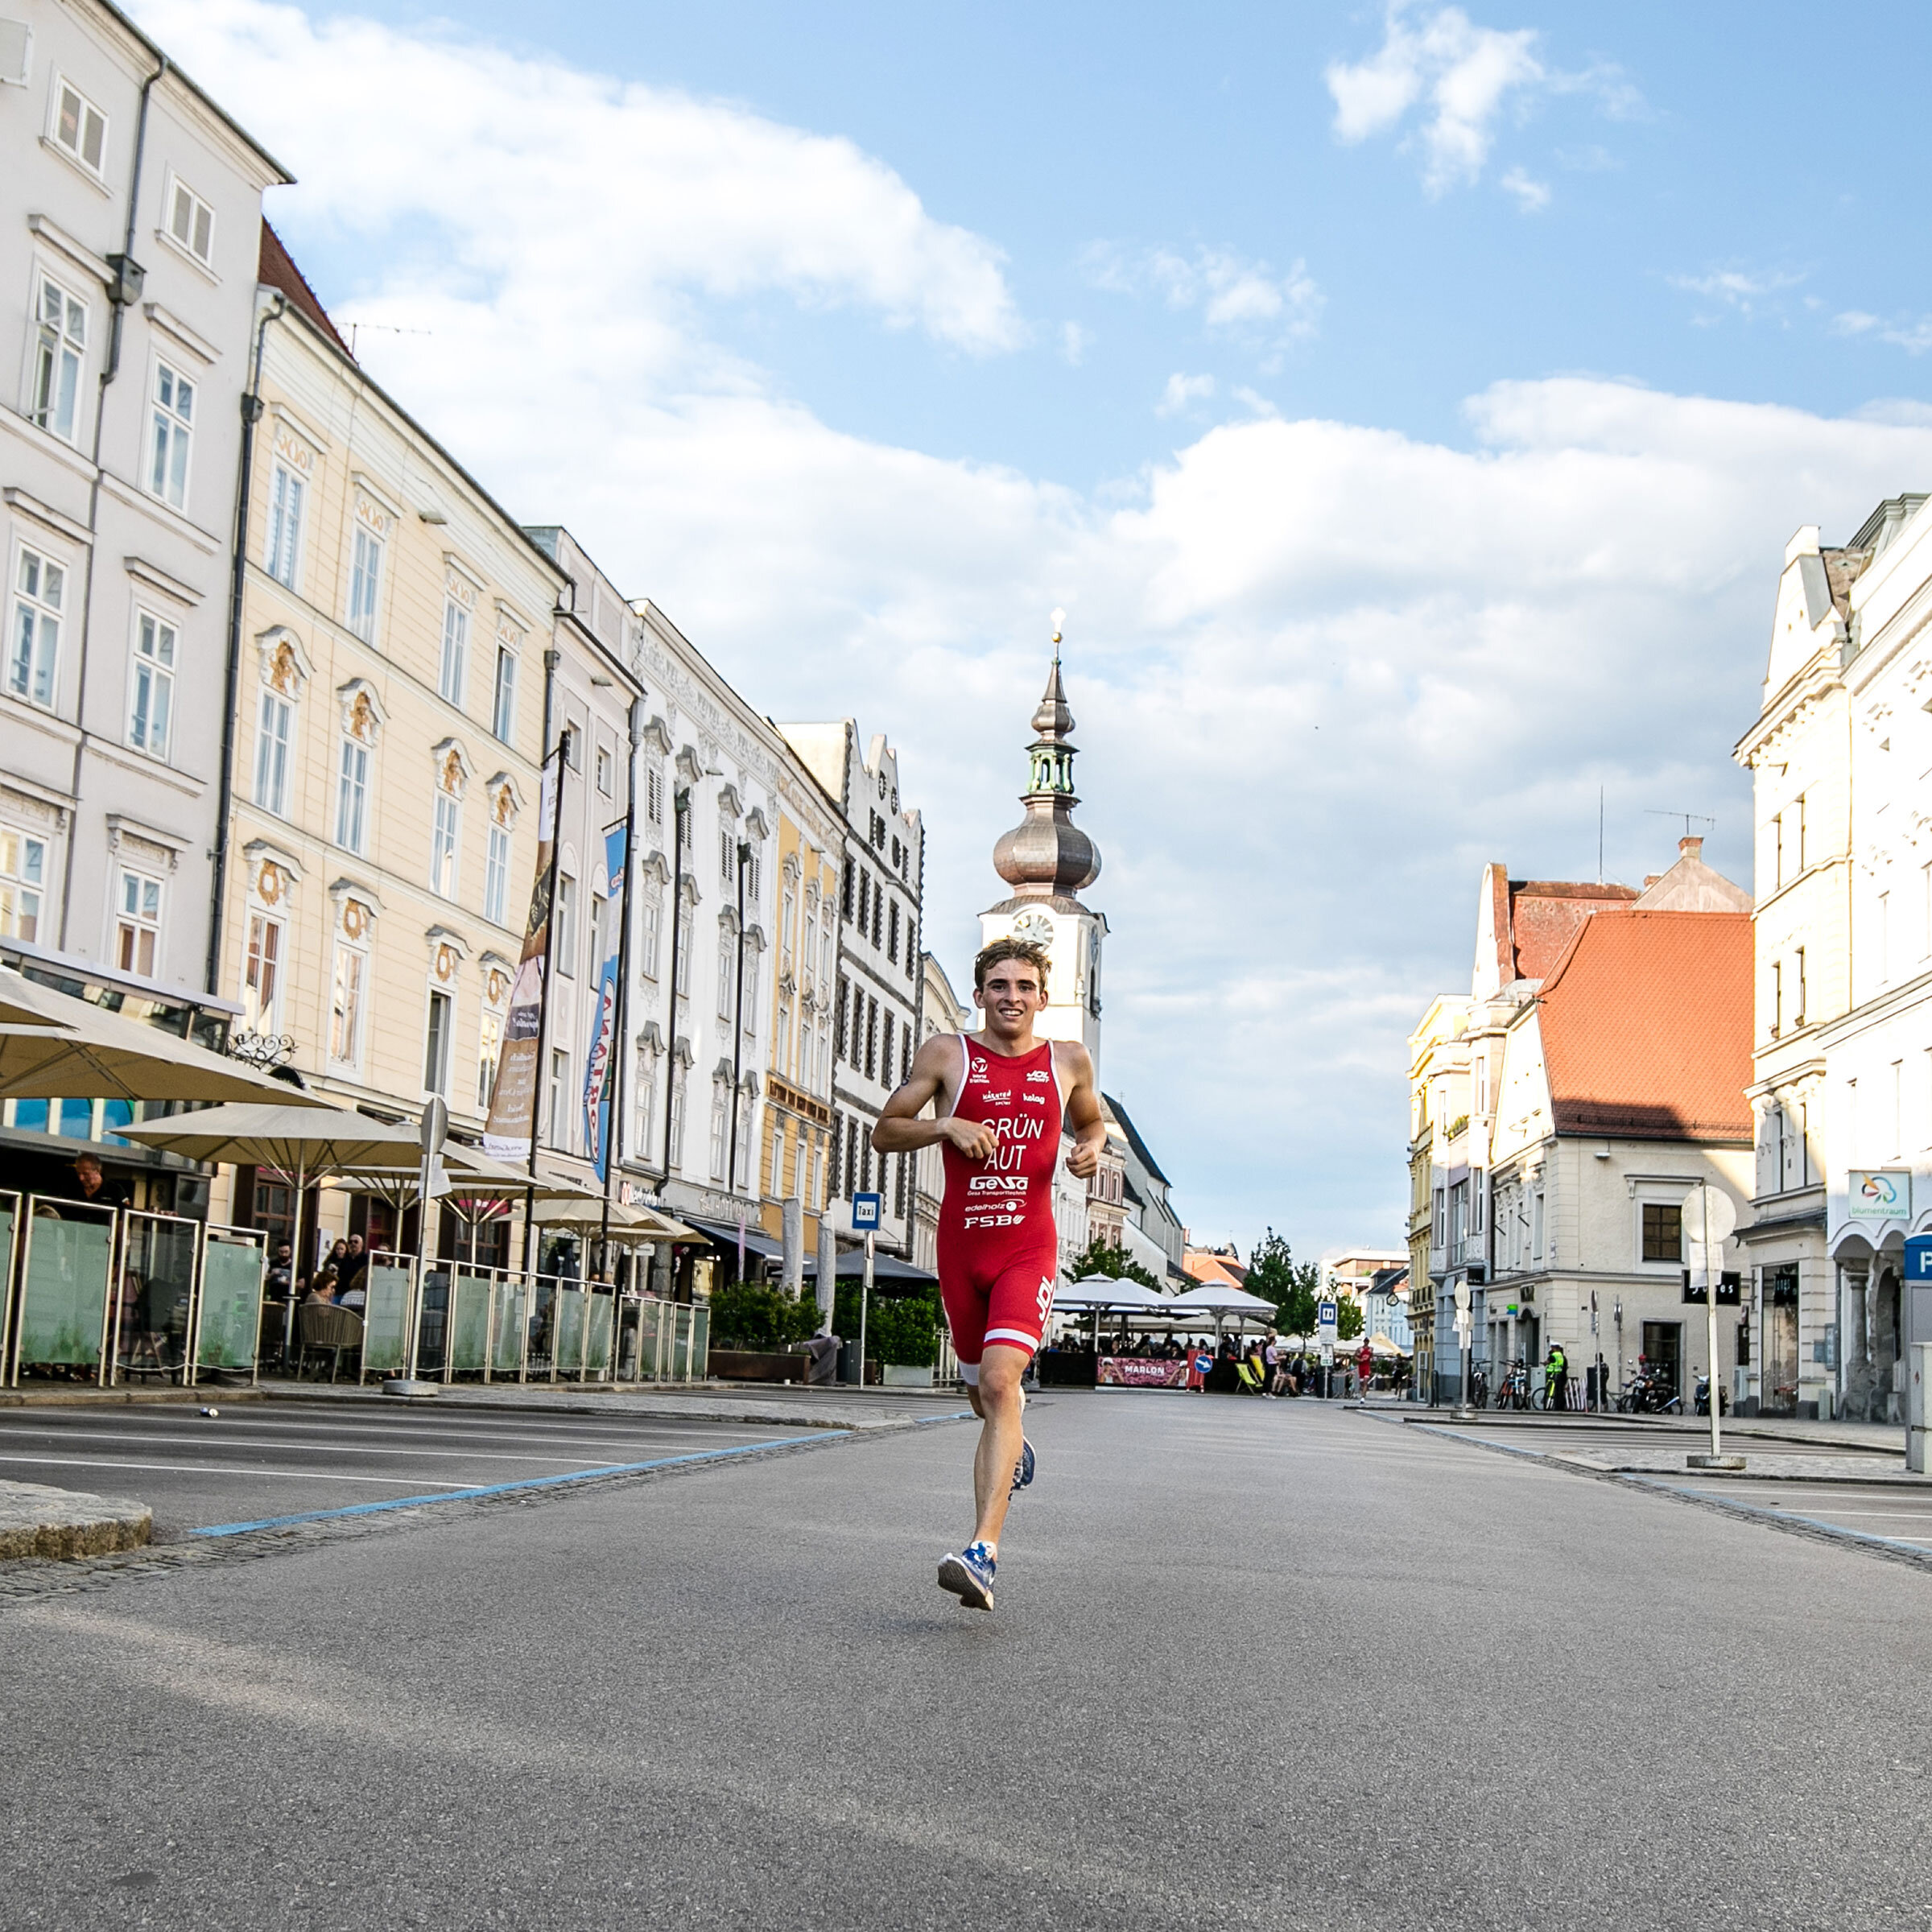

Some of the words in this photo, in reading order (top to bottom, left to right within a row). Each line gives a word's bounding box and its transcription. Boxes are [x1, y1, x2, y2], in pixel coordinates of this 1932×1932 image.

[980, 1113, 1044, 1139] GRÜN
[983, 1145, 1027, 1170] AUT
[858, 1205, 875, 1216] Taxi
[964, 1203, 1006, 1212] edelholz
[1851, 1207, 1908, 1216] blumentraum
[964, 1215, 1013, 1229] FSB
[1124, 1364, 1165, 1377] MARLON
